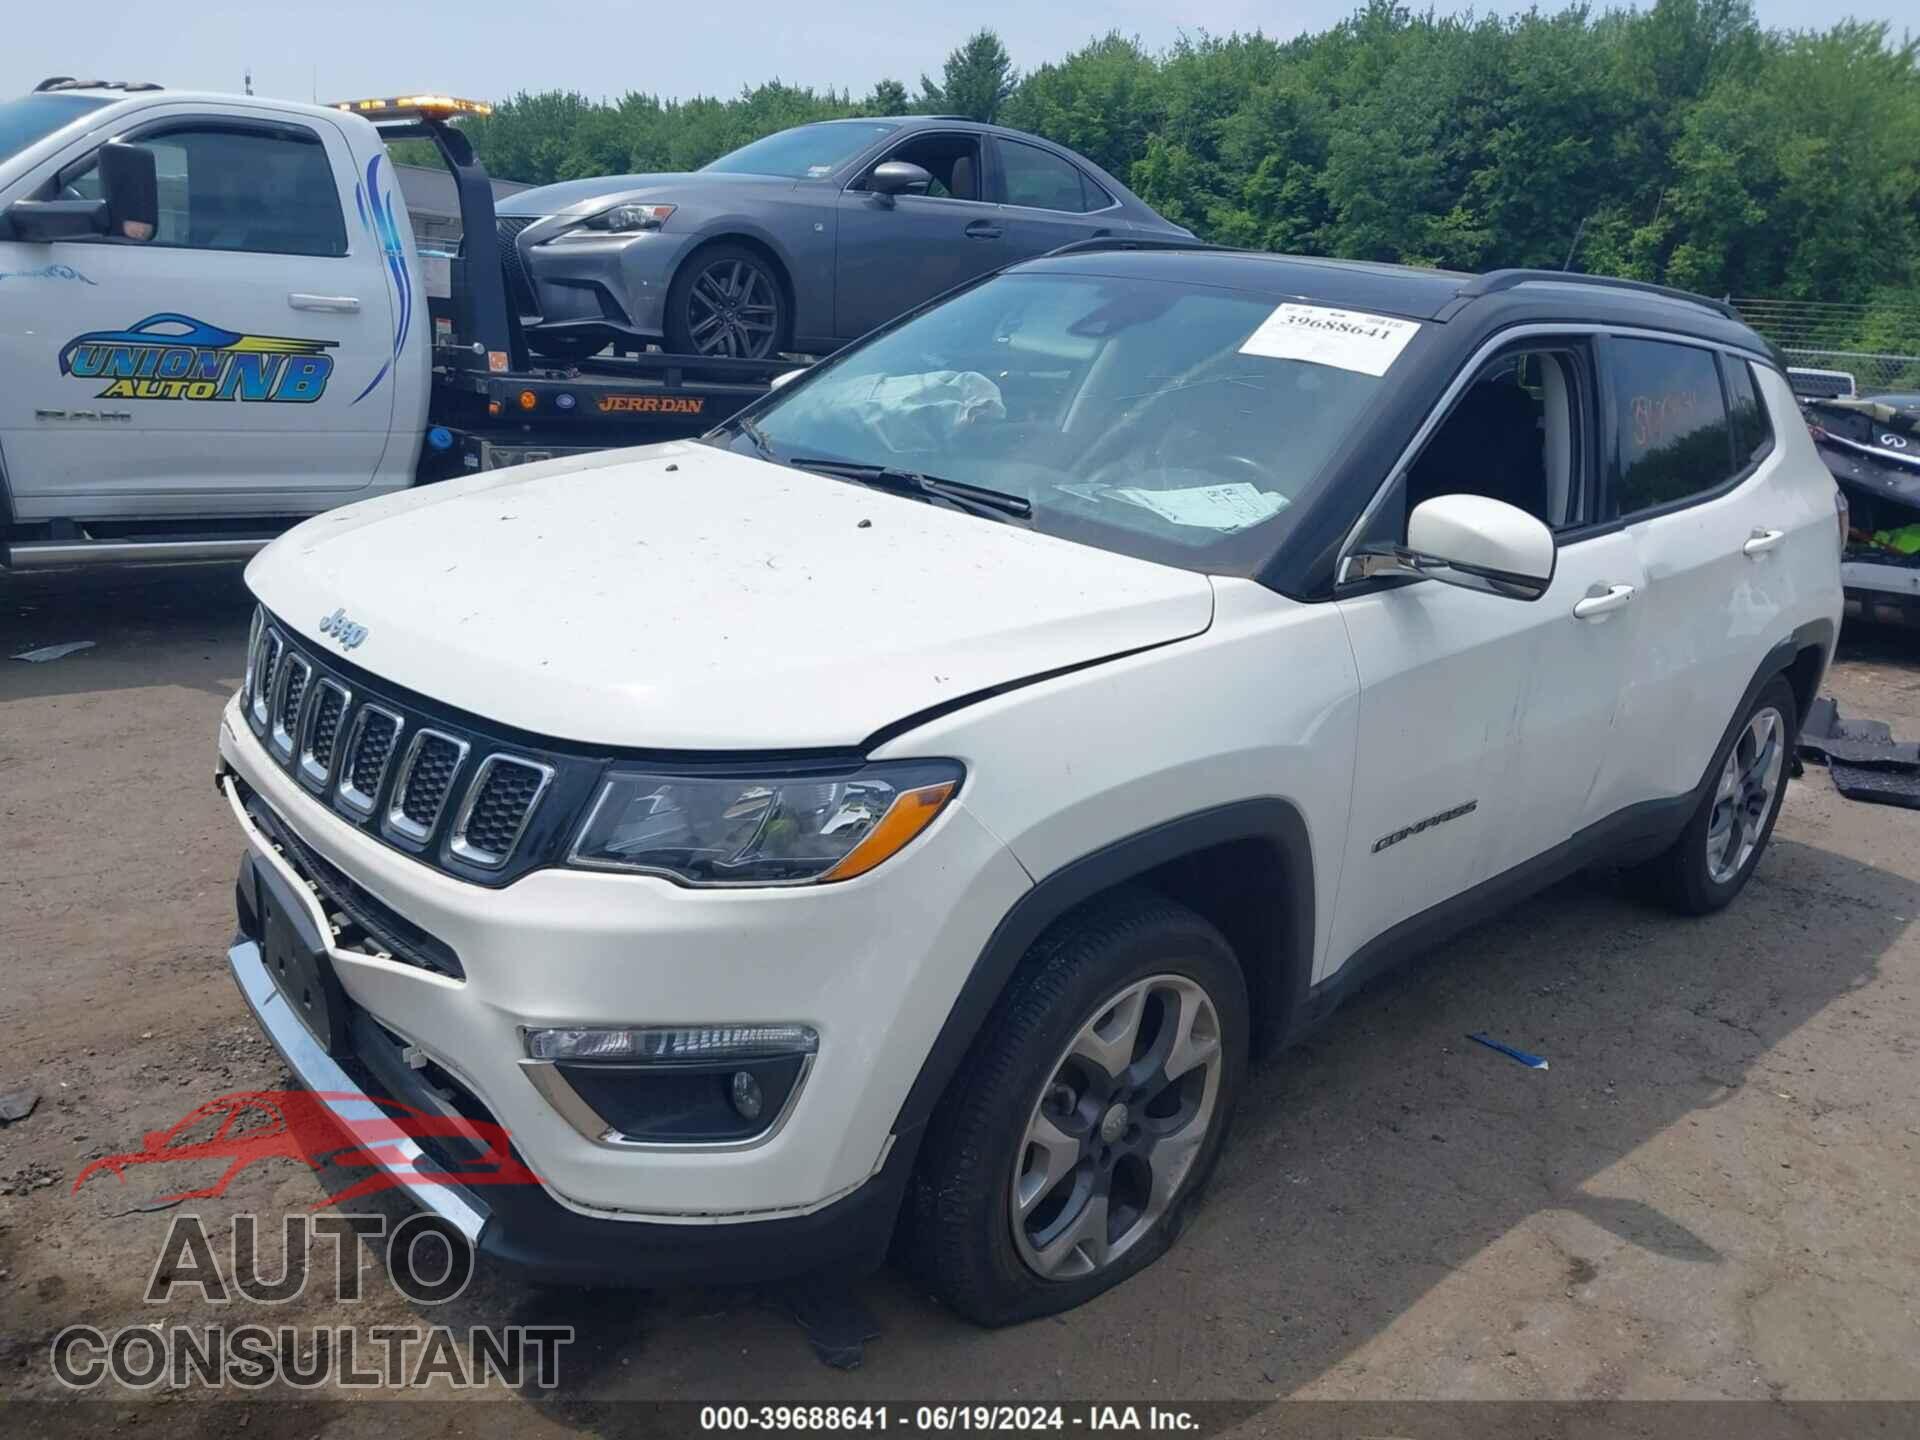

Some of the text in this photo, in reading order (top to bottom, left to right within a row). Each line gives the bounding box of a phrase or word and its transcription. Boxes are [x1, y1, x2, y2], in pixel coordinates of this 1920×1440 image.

[1281, 314, 1392, 340] 39688641
[70, 345, 334, 402] UNION NB
[103, 379, 219, 399] AUTO
